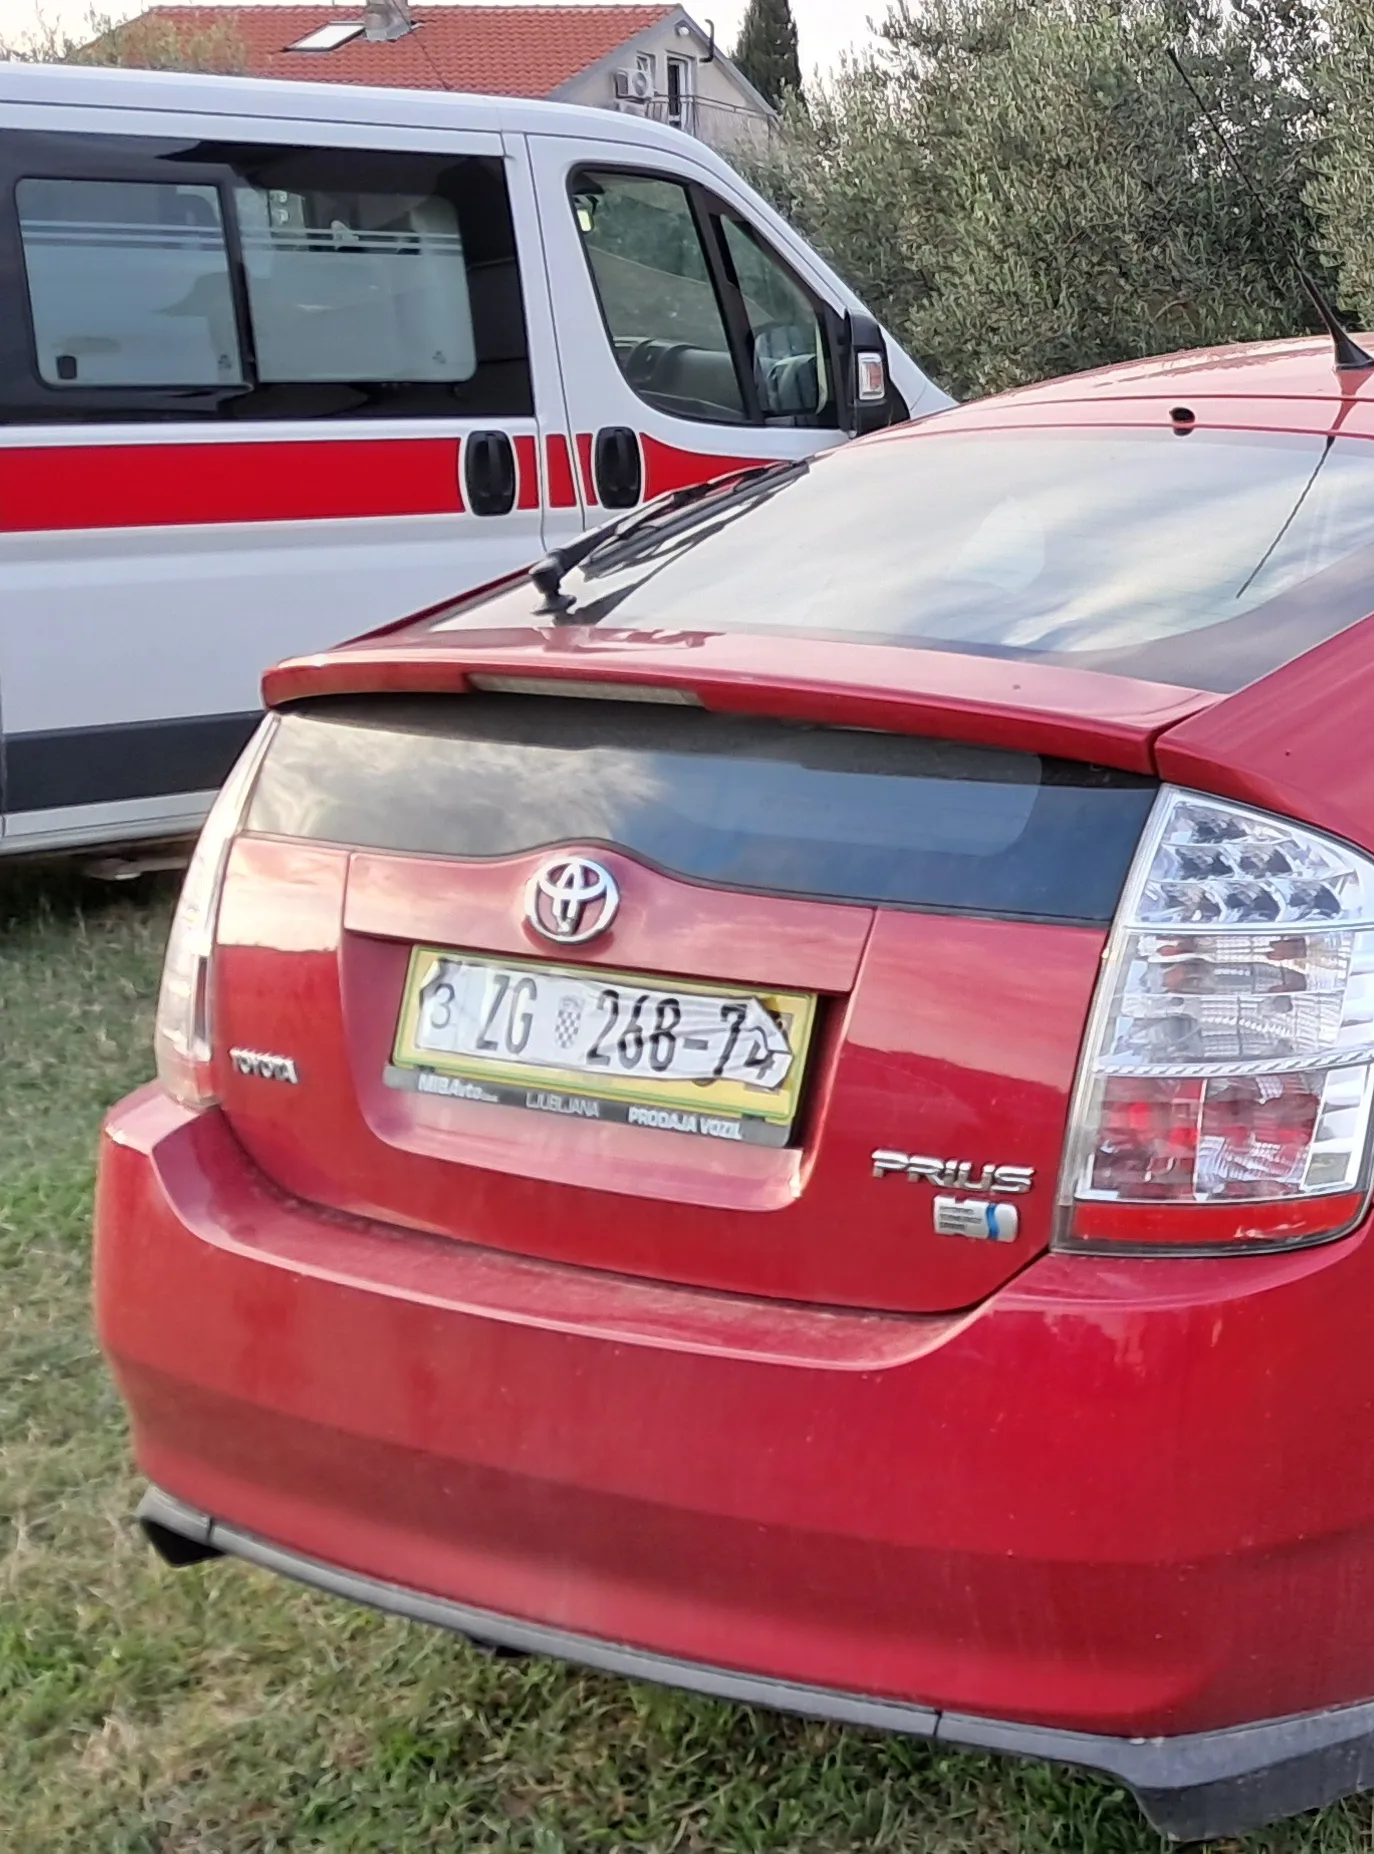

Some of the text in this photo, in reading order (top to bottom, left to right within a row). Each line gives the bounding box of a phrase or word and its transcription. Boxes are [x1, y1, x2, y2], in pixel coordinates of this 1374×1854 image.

[475, 974, 538, 1054] ZG
[229, 1047, 298, 1084] TOYOTA
[526, 1091, 600, 1117] LJUBLJANA
[628, 1106, 697, 1132] PRODAJA
[871, 1149, 1036, 1193] PRIUS
